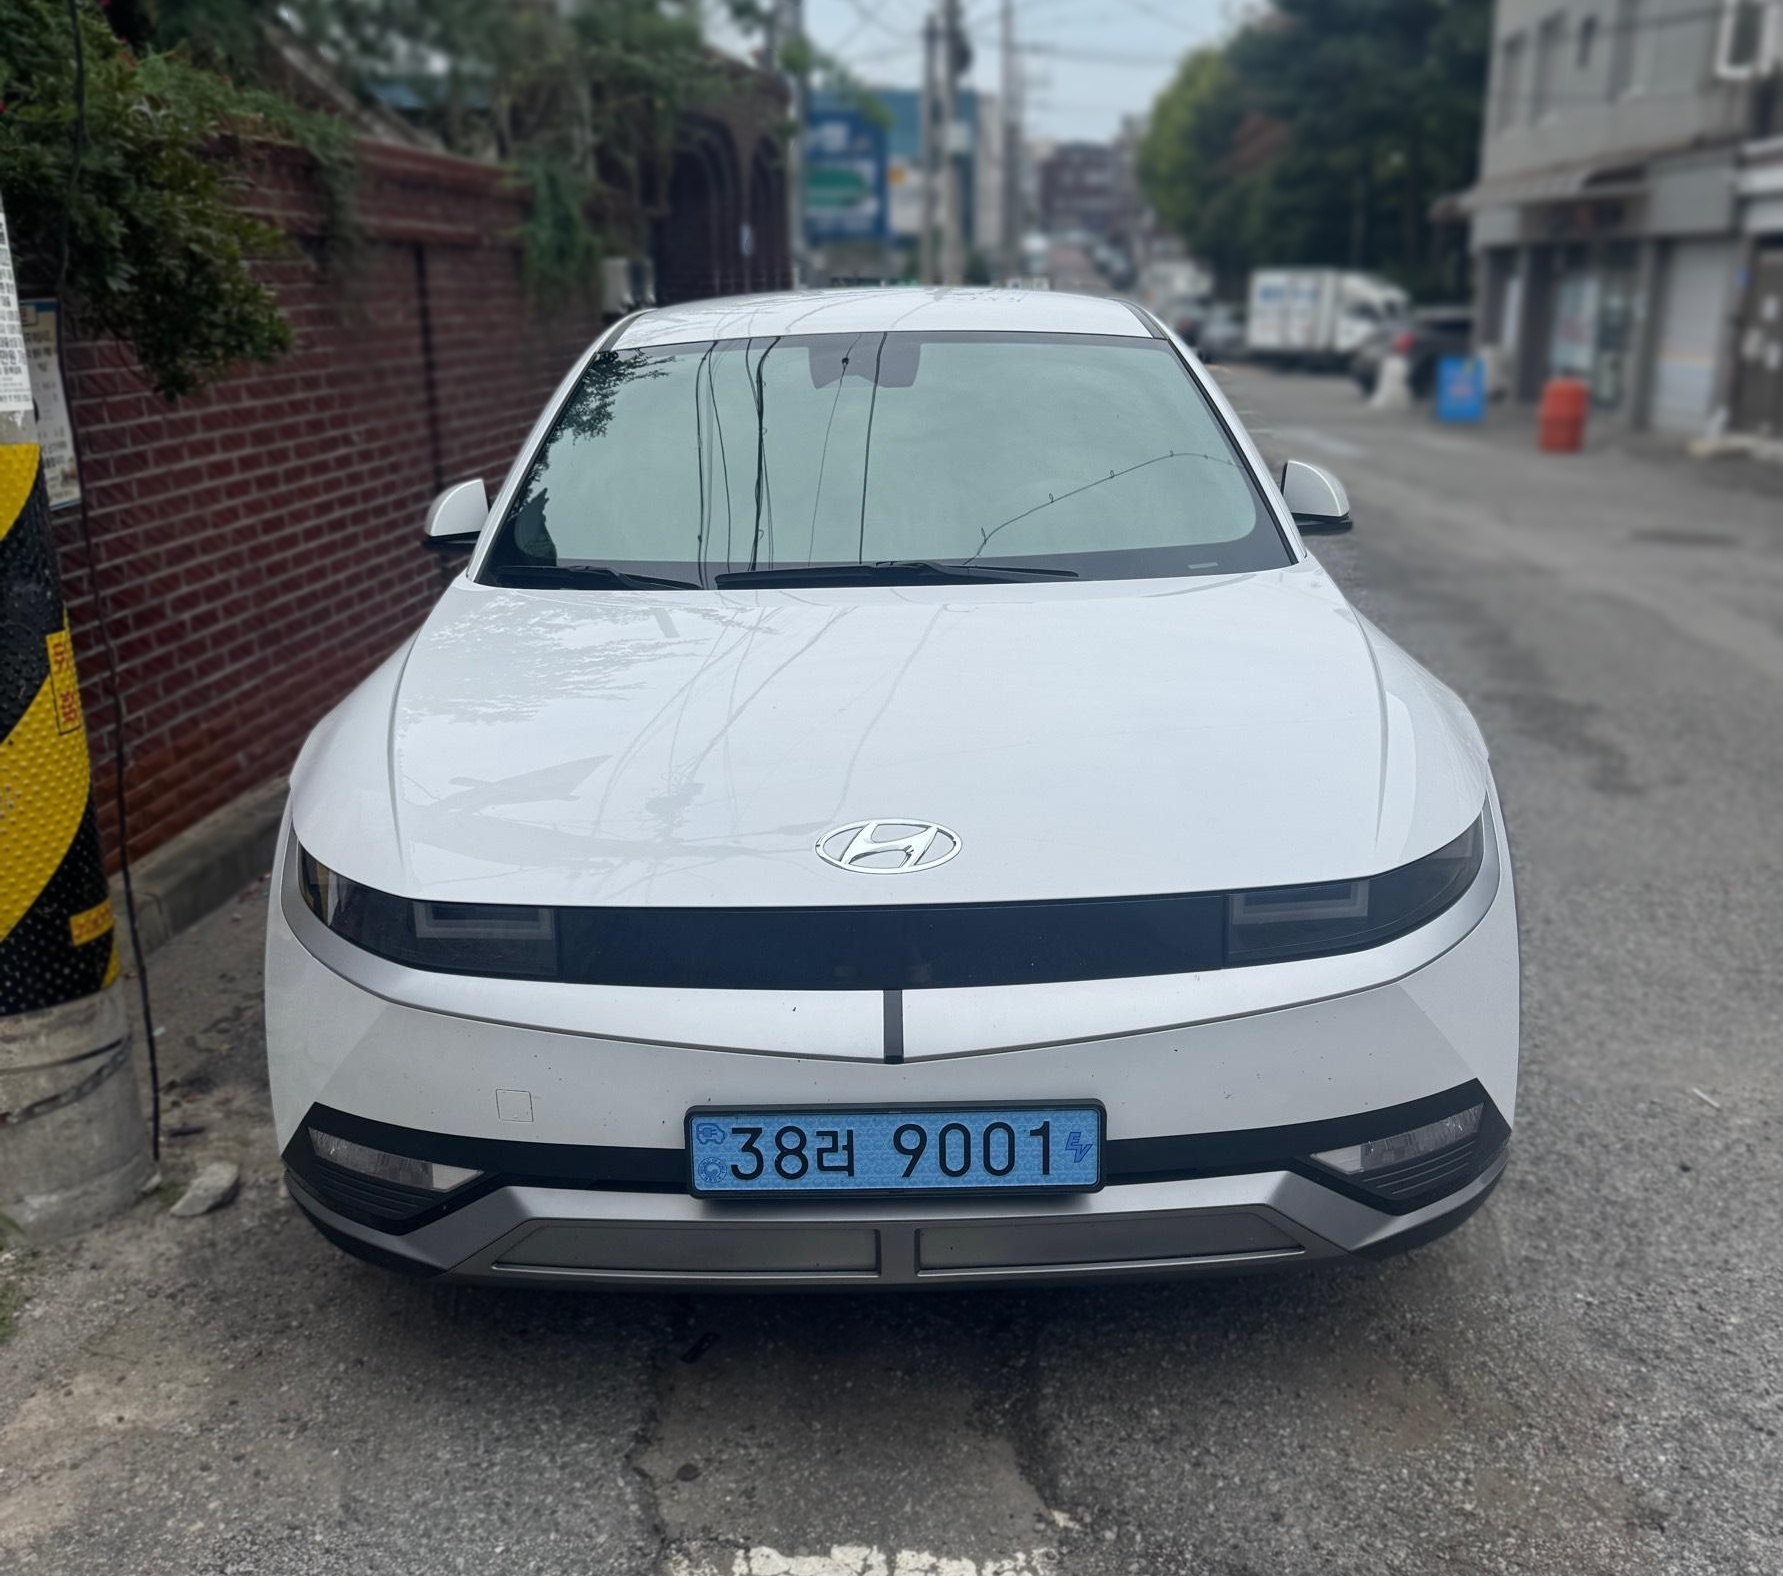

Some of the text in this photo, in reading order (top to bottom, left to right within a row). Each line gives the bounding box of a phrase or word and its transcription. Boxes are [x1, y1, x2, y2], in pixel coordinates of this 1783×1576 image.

[731, 1126, 855, 1181] 38러
[893, 1121, 1050, 1179] 9001
[1065, 1131, 1093, 1163] EV
